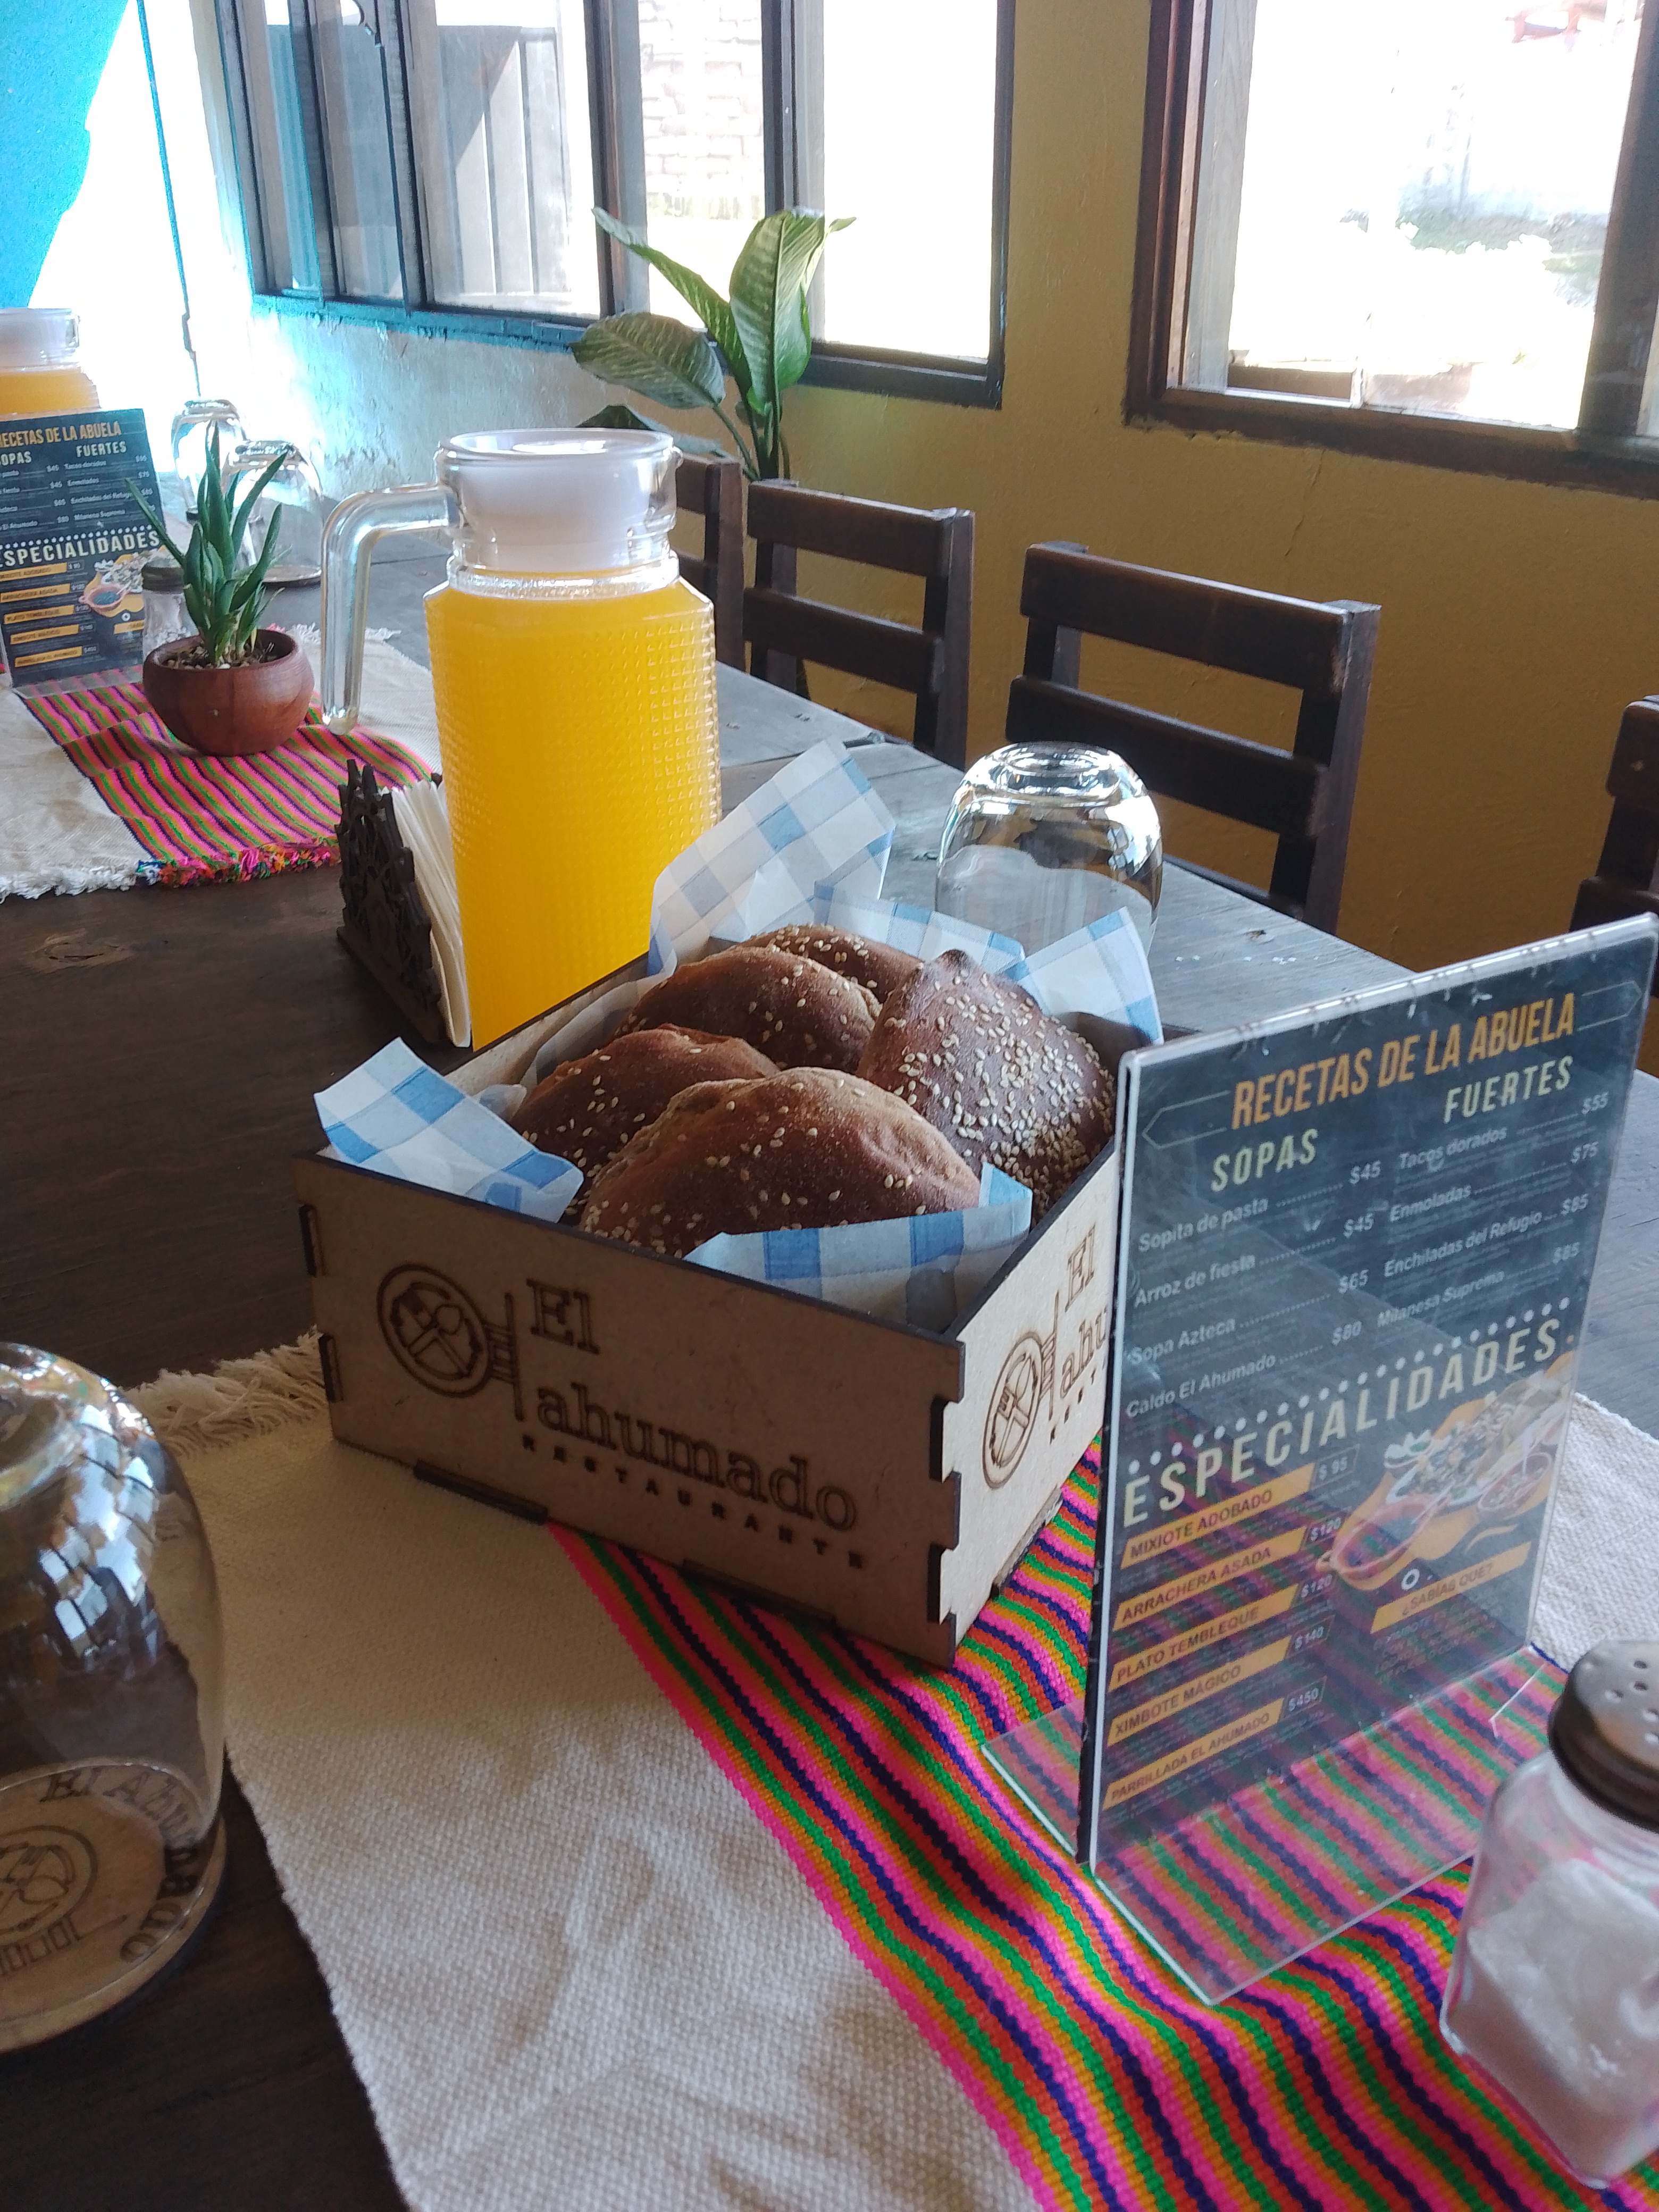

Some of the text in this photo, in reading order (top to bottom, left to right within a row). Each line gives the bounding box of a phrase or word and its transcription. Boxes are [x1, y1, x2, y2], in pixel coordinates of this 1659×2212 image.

[0, 440, 127, 466] OPAS FUERTES
[45, 427, 62, 443] DE
[62, 425, 78, 441] LA
[79, 421, 122, 438] ABUELA
[1231, 992, 1575, 1129] RECETAS DE LA ABUELA
[1443, 1055, 1574, 1124] FUERTES
[1210, 1127, 1319, 1193] SOPAS
[1389, 1185, 1472, 1222] Enmoladas
[1570, 1141, 1599, 1164] $75
[1399, 1145, 1445, 1170] Tacos
[1446, 1127, 1508, 1157] dorados
[1138, 1222, 1194, 1252] Sopita
[1196, 1213, 1219, 1234] de
[1220, 1197, 1269, 1229] pasta
[1348, 1160, 1381, 1186] $45
[1384, 1238, 1463, 1277] Enchiladas
[1464, 1227, 1488, 1249] del
[1489, 1211, 1543, 1239] Refugio
[1065, 1222, 1095, 1313] El
[1133, 1279, 1181, 1309] Arroz
[1184, 1270, 1206, 1291] de
[1209, 1254, 1256, 1283] fiesta
[1343, 1213, 1375, 1239] $45
[527, 1278, 599, 1355] El
[1129, 1269, 1370, 1365] Sopa Azteca $65
[1126, 1320, 1363, 1419] Caldo El Ahumado $80
[537, 1383, 856, 1531] ahumado
[1123, 1319, 1560, 1529] ESPECIALIDADES
[1130, 1521, 1193, 1559] MIXIOTE
[1197, 1490, 1273, 1531] ADOBADO
[1122, 1570, 1218, 1623] ARRACHERA
[1220, 1547, 1271, 1579] ASADA
[1117, 1648, 1166, 1682] PLATO
[1169, 1606, 1260, 1658] TEMBLEQUE
[1116, 1694, 1179, 1738] XIMBOTE
[1110, 1753, 1189, 1802] PARRILLADA
[1191, 1743, 1205, 1760] EL
[1209, 1711, 1271, 1749] AHUMADO
